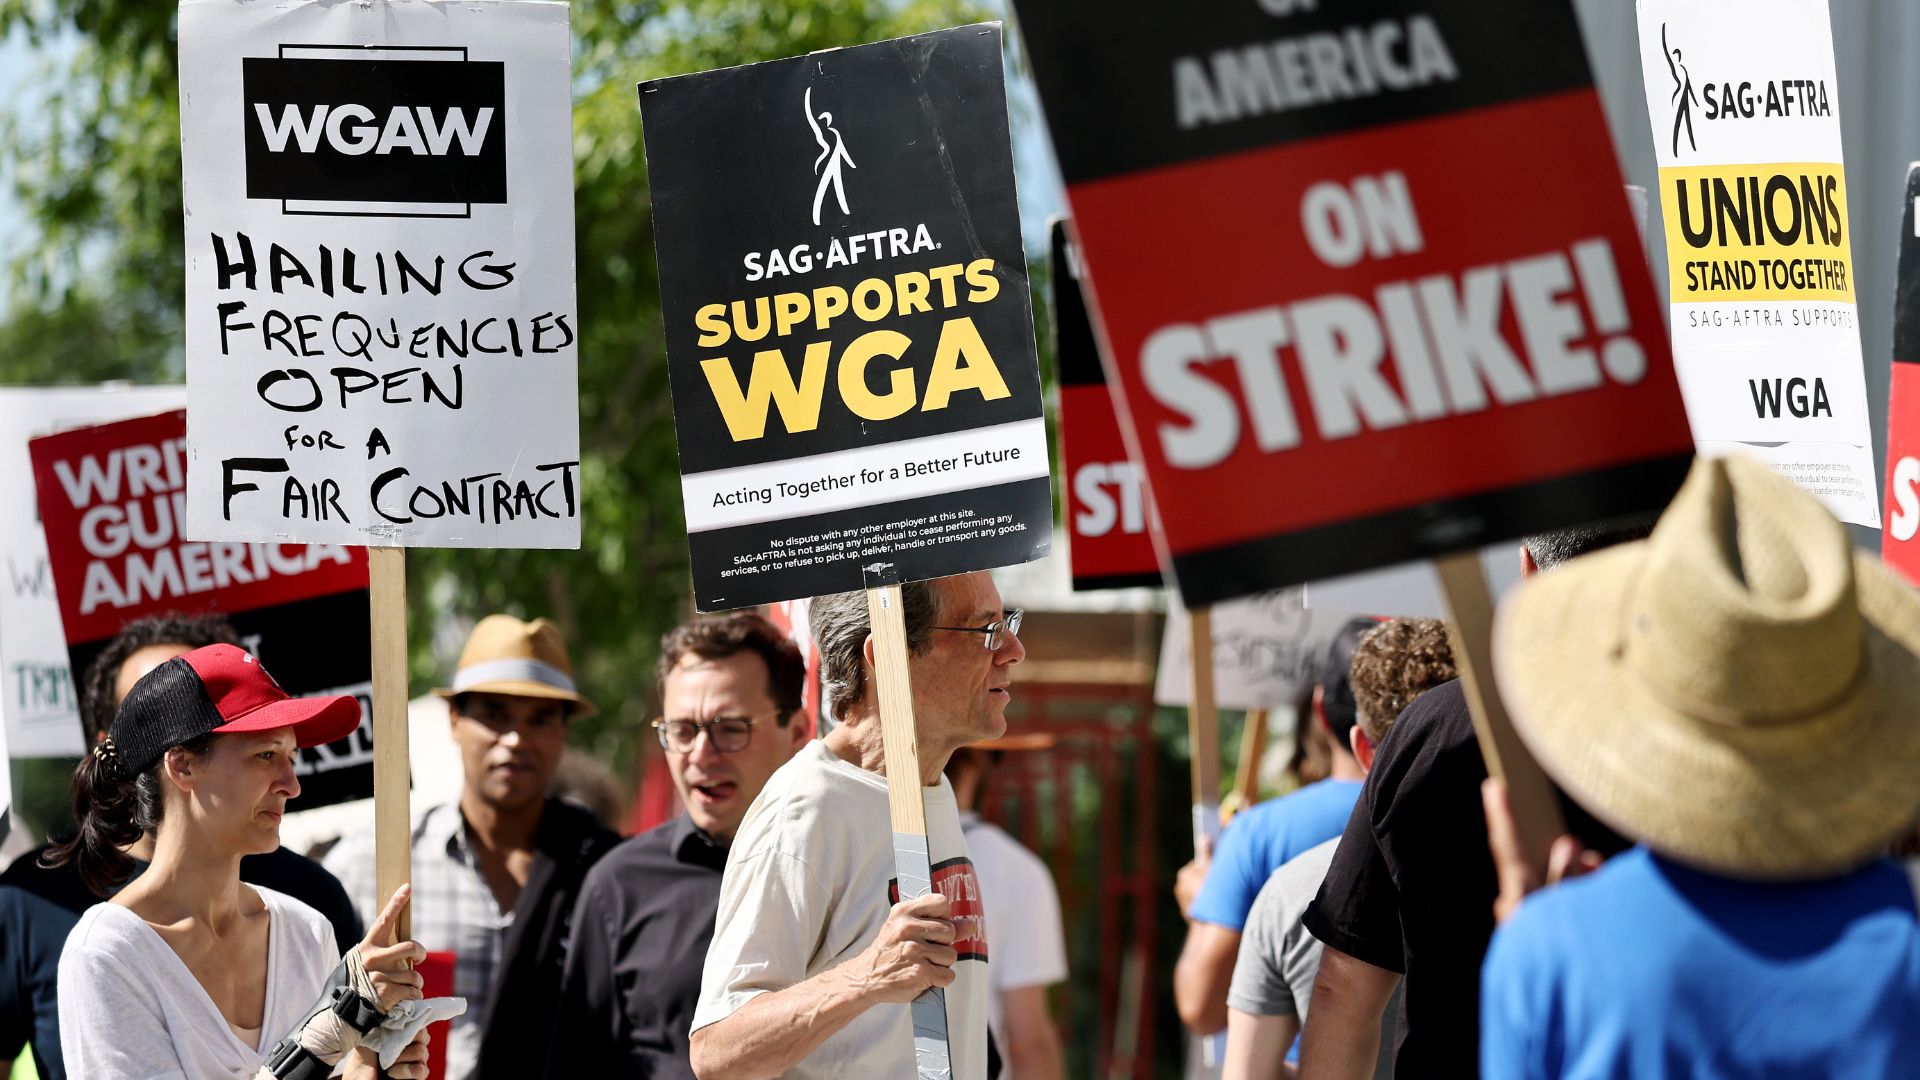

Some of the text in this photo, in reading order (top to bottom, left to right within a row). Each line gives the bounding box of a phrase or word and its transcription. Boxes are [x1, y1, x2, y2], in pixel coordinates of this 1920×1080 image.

[1174, 14, 1460, 130] AMERICA
[253, 102, 495, 157] WGAW
[1302, 170, 1424, 268] ON
[1676, 174, 1842, 249] UNIONS
[210, 231, 517, 298] HAILING
[1686, 258, 1848, 292] STAND TOGETHER
[217, 301, 575, 362] FREQUENCIES
[694, 257, 1000, 348] SUPPORTS
[1689, 308, 1852, 329] SAG-AFTRA SUPPORTS
[699, 316, 1012, 443] WGA
[1139, 238, 1648, 470] STRIKE!
[256, 364, 463, 412] OPEN
[1748, 376, 1833, 419] WGA
[53, 436, 187, 510] WRI
[367, 427, 391, 459] A
[221, 458, 580, 525] FAIR CONTRACT
[712, 447, 1021, 508] Acting Together for a Better Future
[720, 522, 1027, 578] services, or to refuse to pick up, deliver, handle or transport any goods.
[734, 514, 1013, 565] SAG-AFTRA is not asking any individual to cease performing any
[770, 509, 976, 549] No dispute with any other employer at this site.
